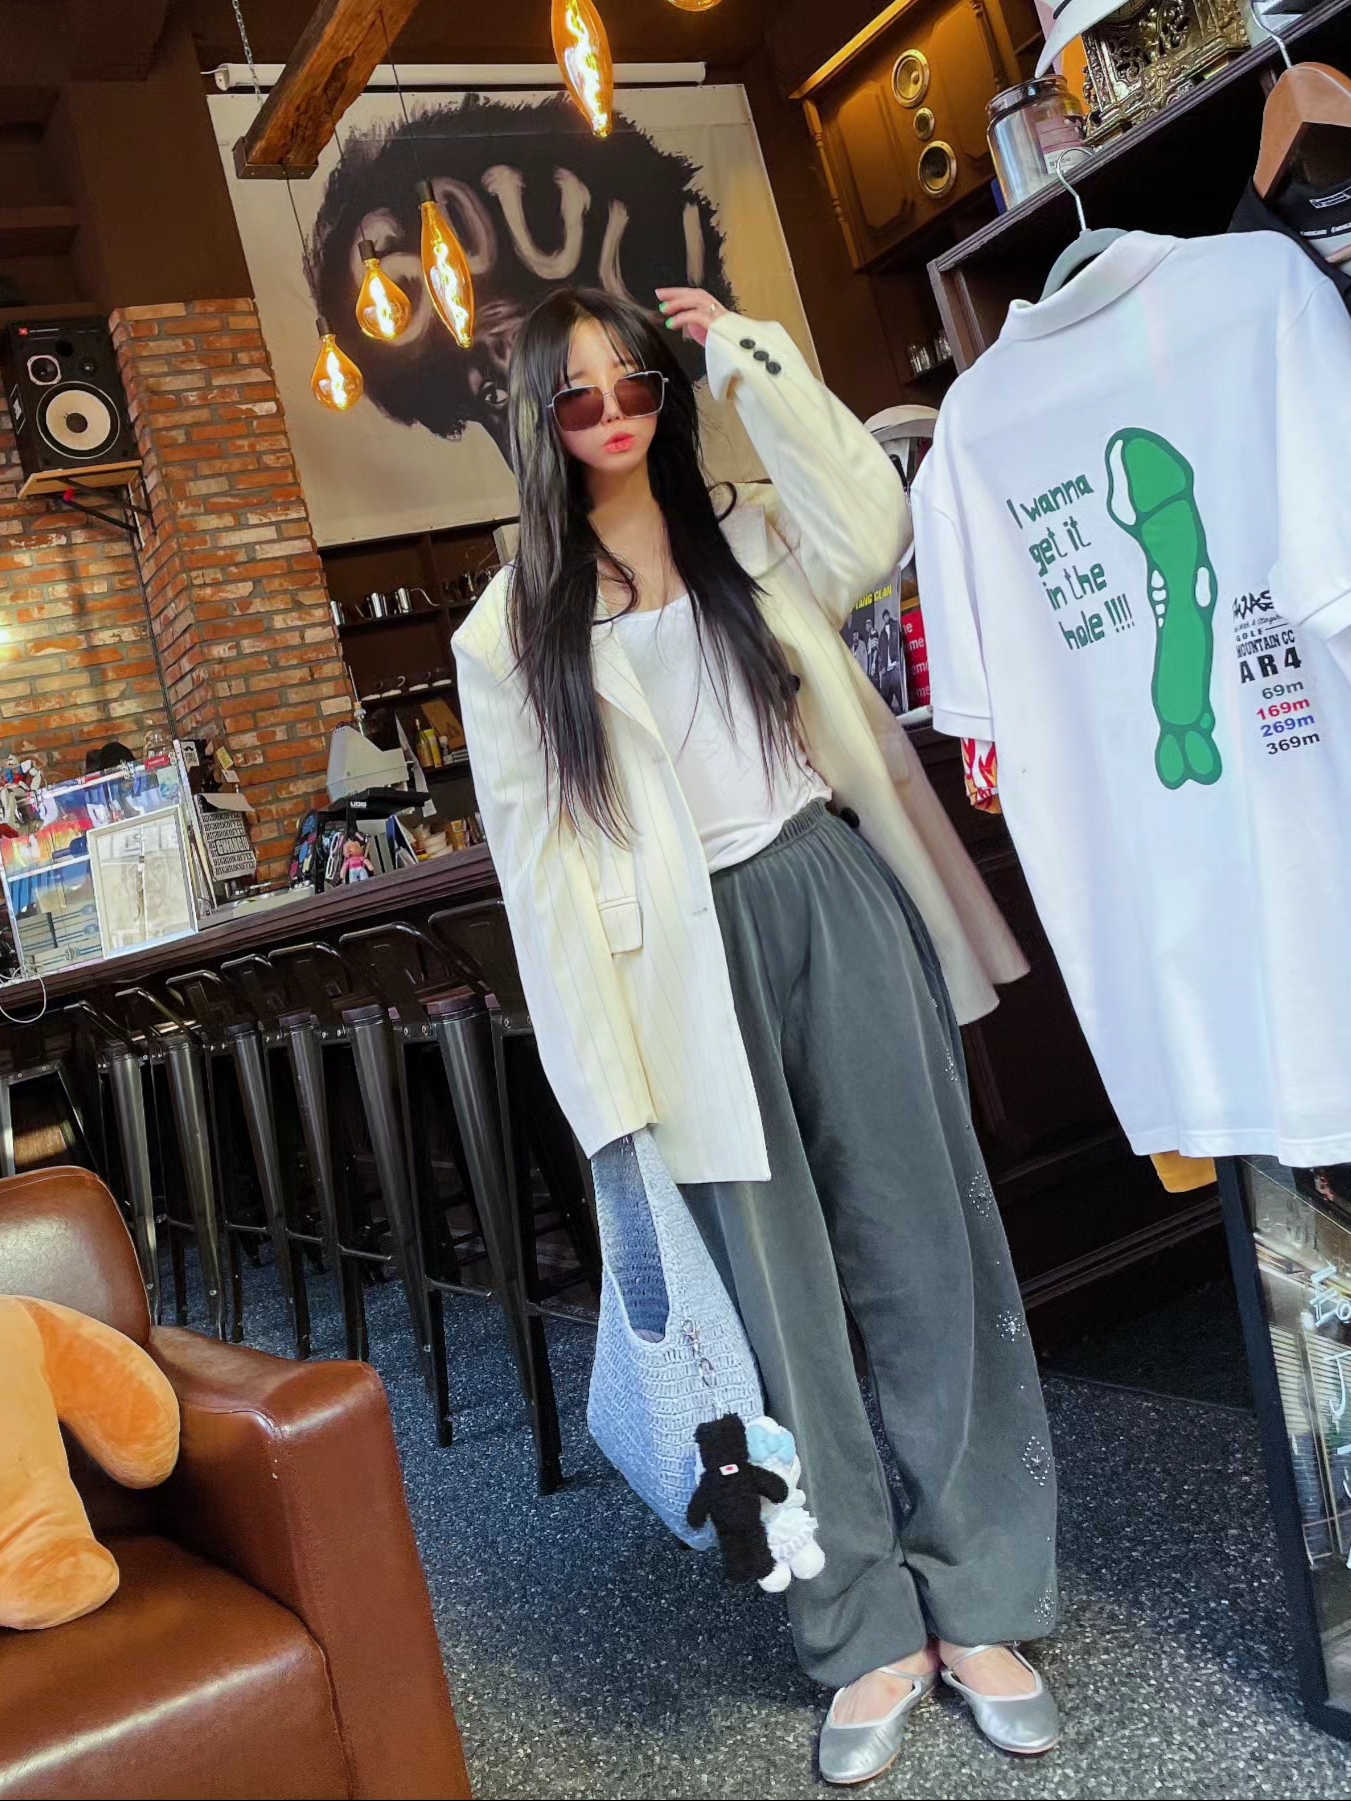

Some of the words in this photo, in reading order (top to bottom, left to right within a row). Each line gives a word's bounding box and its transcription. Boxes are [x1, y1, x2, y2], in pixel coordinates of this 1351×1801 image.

[1006, 498, 1023, 529] I
[1019, 474, 1094, 522] wanna
[1029, 527, 1068, 577] get
[1063, 516, 1092, 551] it
[874, 584, 892, 602] CLAN
[1042, 581, 1068, 611] in
[1063, 563, 1107, 600] the
[1236, 628, 1263, 642] GOLF
[1236, 633, 1281, 658] MOUNTAIN
[1281, 629, 1295, 645] CC
[1262, 681, 1304, 699] 69m
[1256, 698, 1310, 720] 169m
[1260, 714, 1315, 737] 269m
[1266, 733, 1320, 755] 369m
